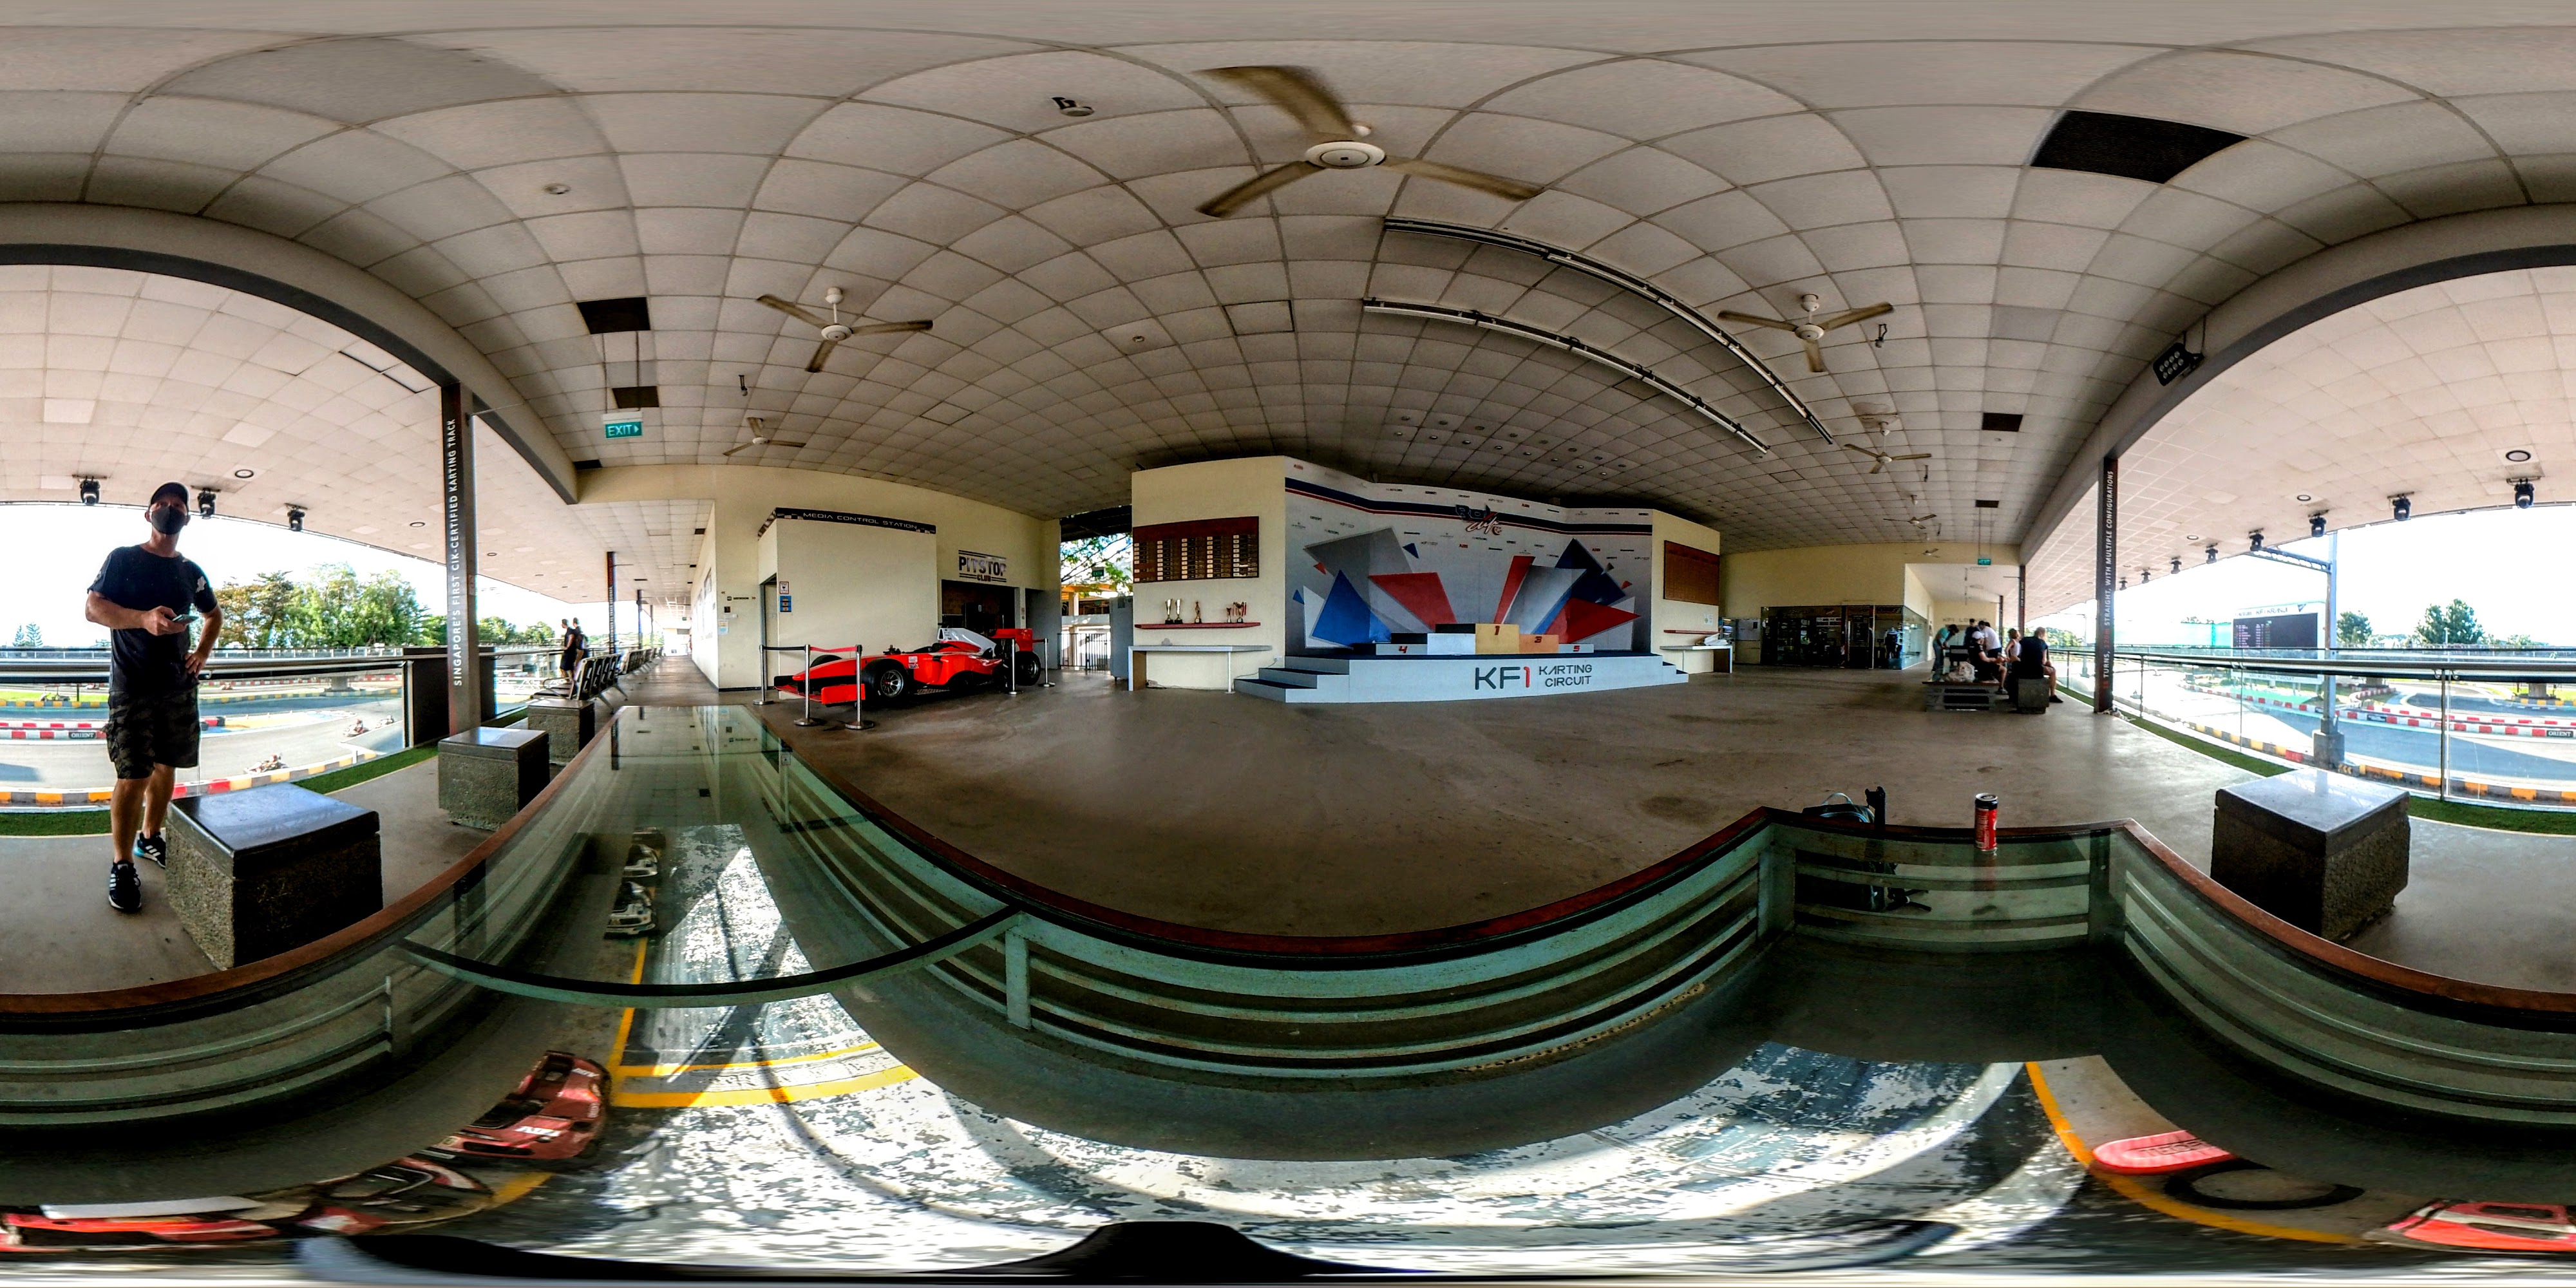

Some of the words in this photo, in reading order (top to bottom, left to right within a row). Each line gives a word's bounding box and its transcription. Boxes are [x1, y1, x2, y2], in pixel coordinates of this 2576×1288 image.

[447, 419, 456, 448] TRACK
[607, 425, 632, 436] EXIT
[448, 450, 457, 492] KARTING
[2106, 471, 2114, 529] CONFIGURATIONS
[449, 495, 460, 571] CIK-CERTIFIED
[837, 515, 879, 524] CONTROL
[882, 520, 917, 529] STATION
[959, 556, 1007, 576] PITSTOP
[452, 575, 460, 605] FIRST
[1494, 625, 1501, 636] 1
[453, 610, 462, 686] SINGAPORE'S
[1398, 645, 1408, 654] 4
[1475, 666, 1530, 690] KF1
[1539, 664, 1593, 676] KARTING
[1545, 676, 1592, 687] CIRCUIT
